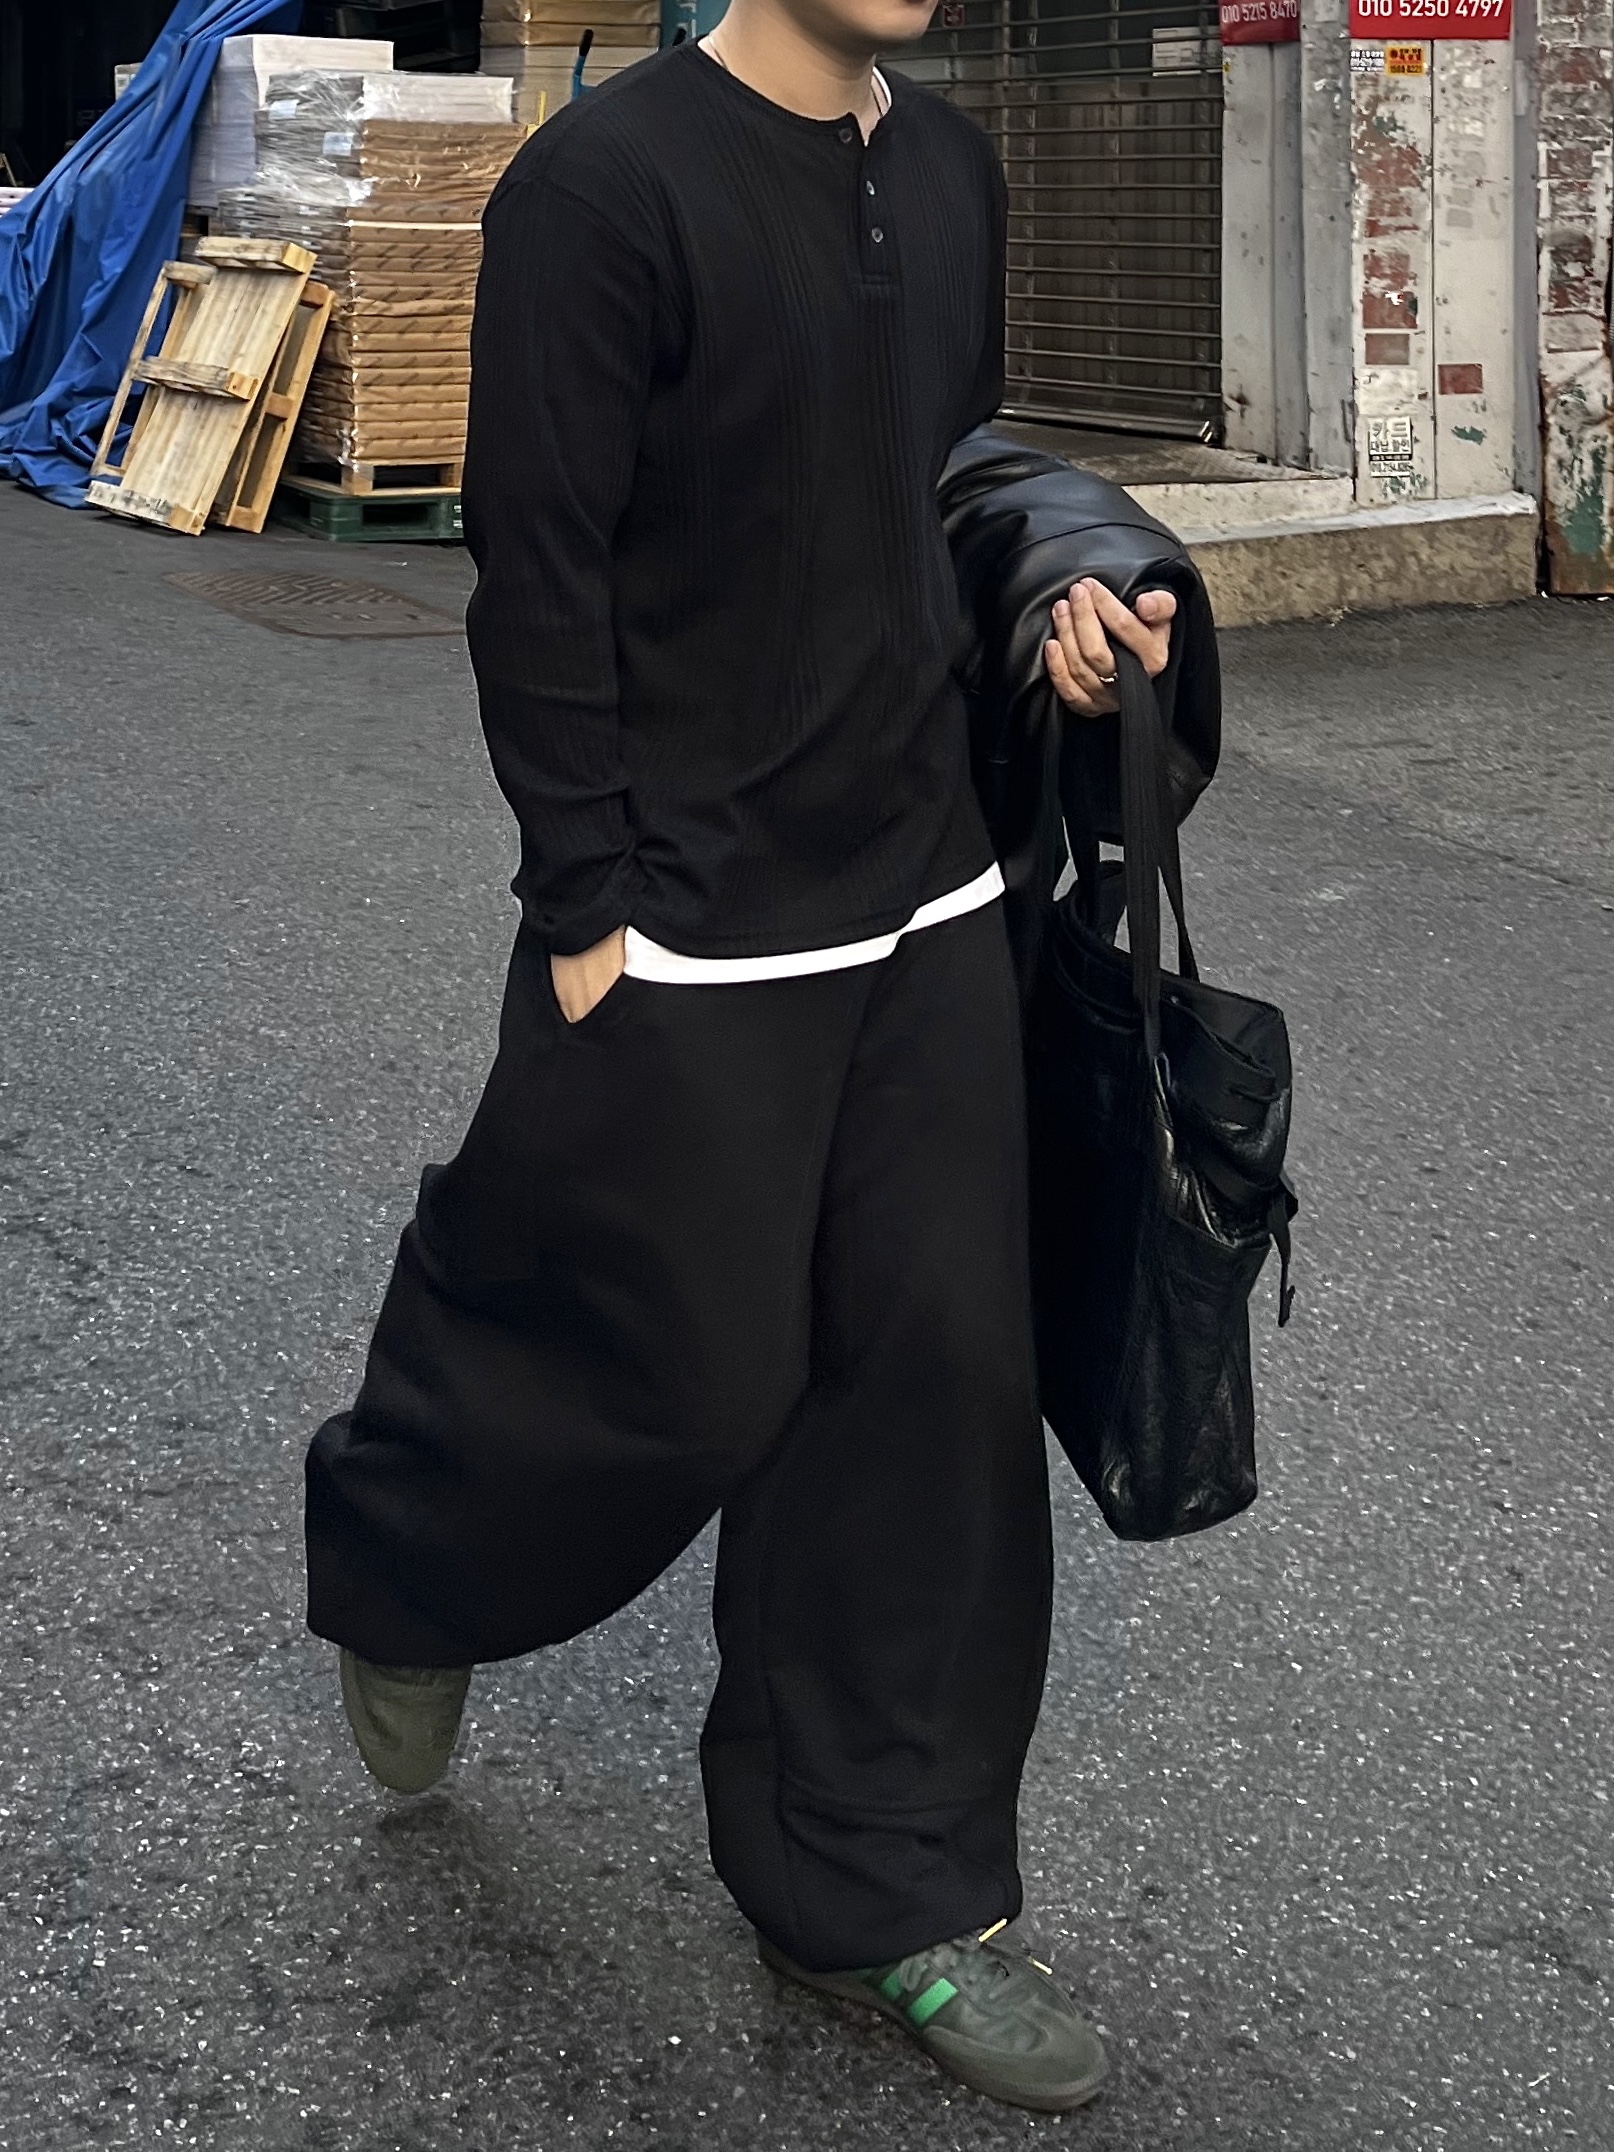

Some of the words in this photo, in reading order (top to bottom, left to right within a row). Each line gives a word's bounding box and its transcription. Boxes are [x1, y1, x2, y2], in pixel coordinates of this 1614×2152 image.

[1222, 5, 1240, 23] 010
[1242, 2, 1268, 22] 5215
[1358, 0, 1393, 17] 010
[1399, 0, 1450, 17] 5250
[1455, 0, 1504, 17] 4797
